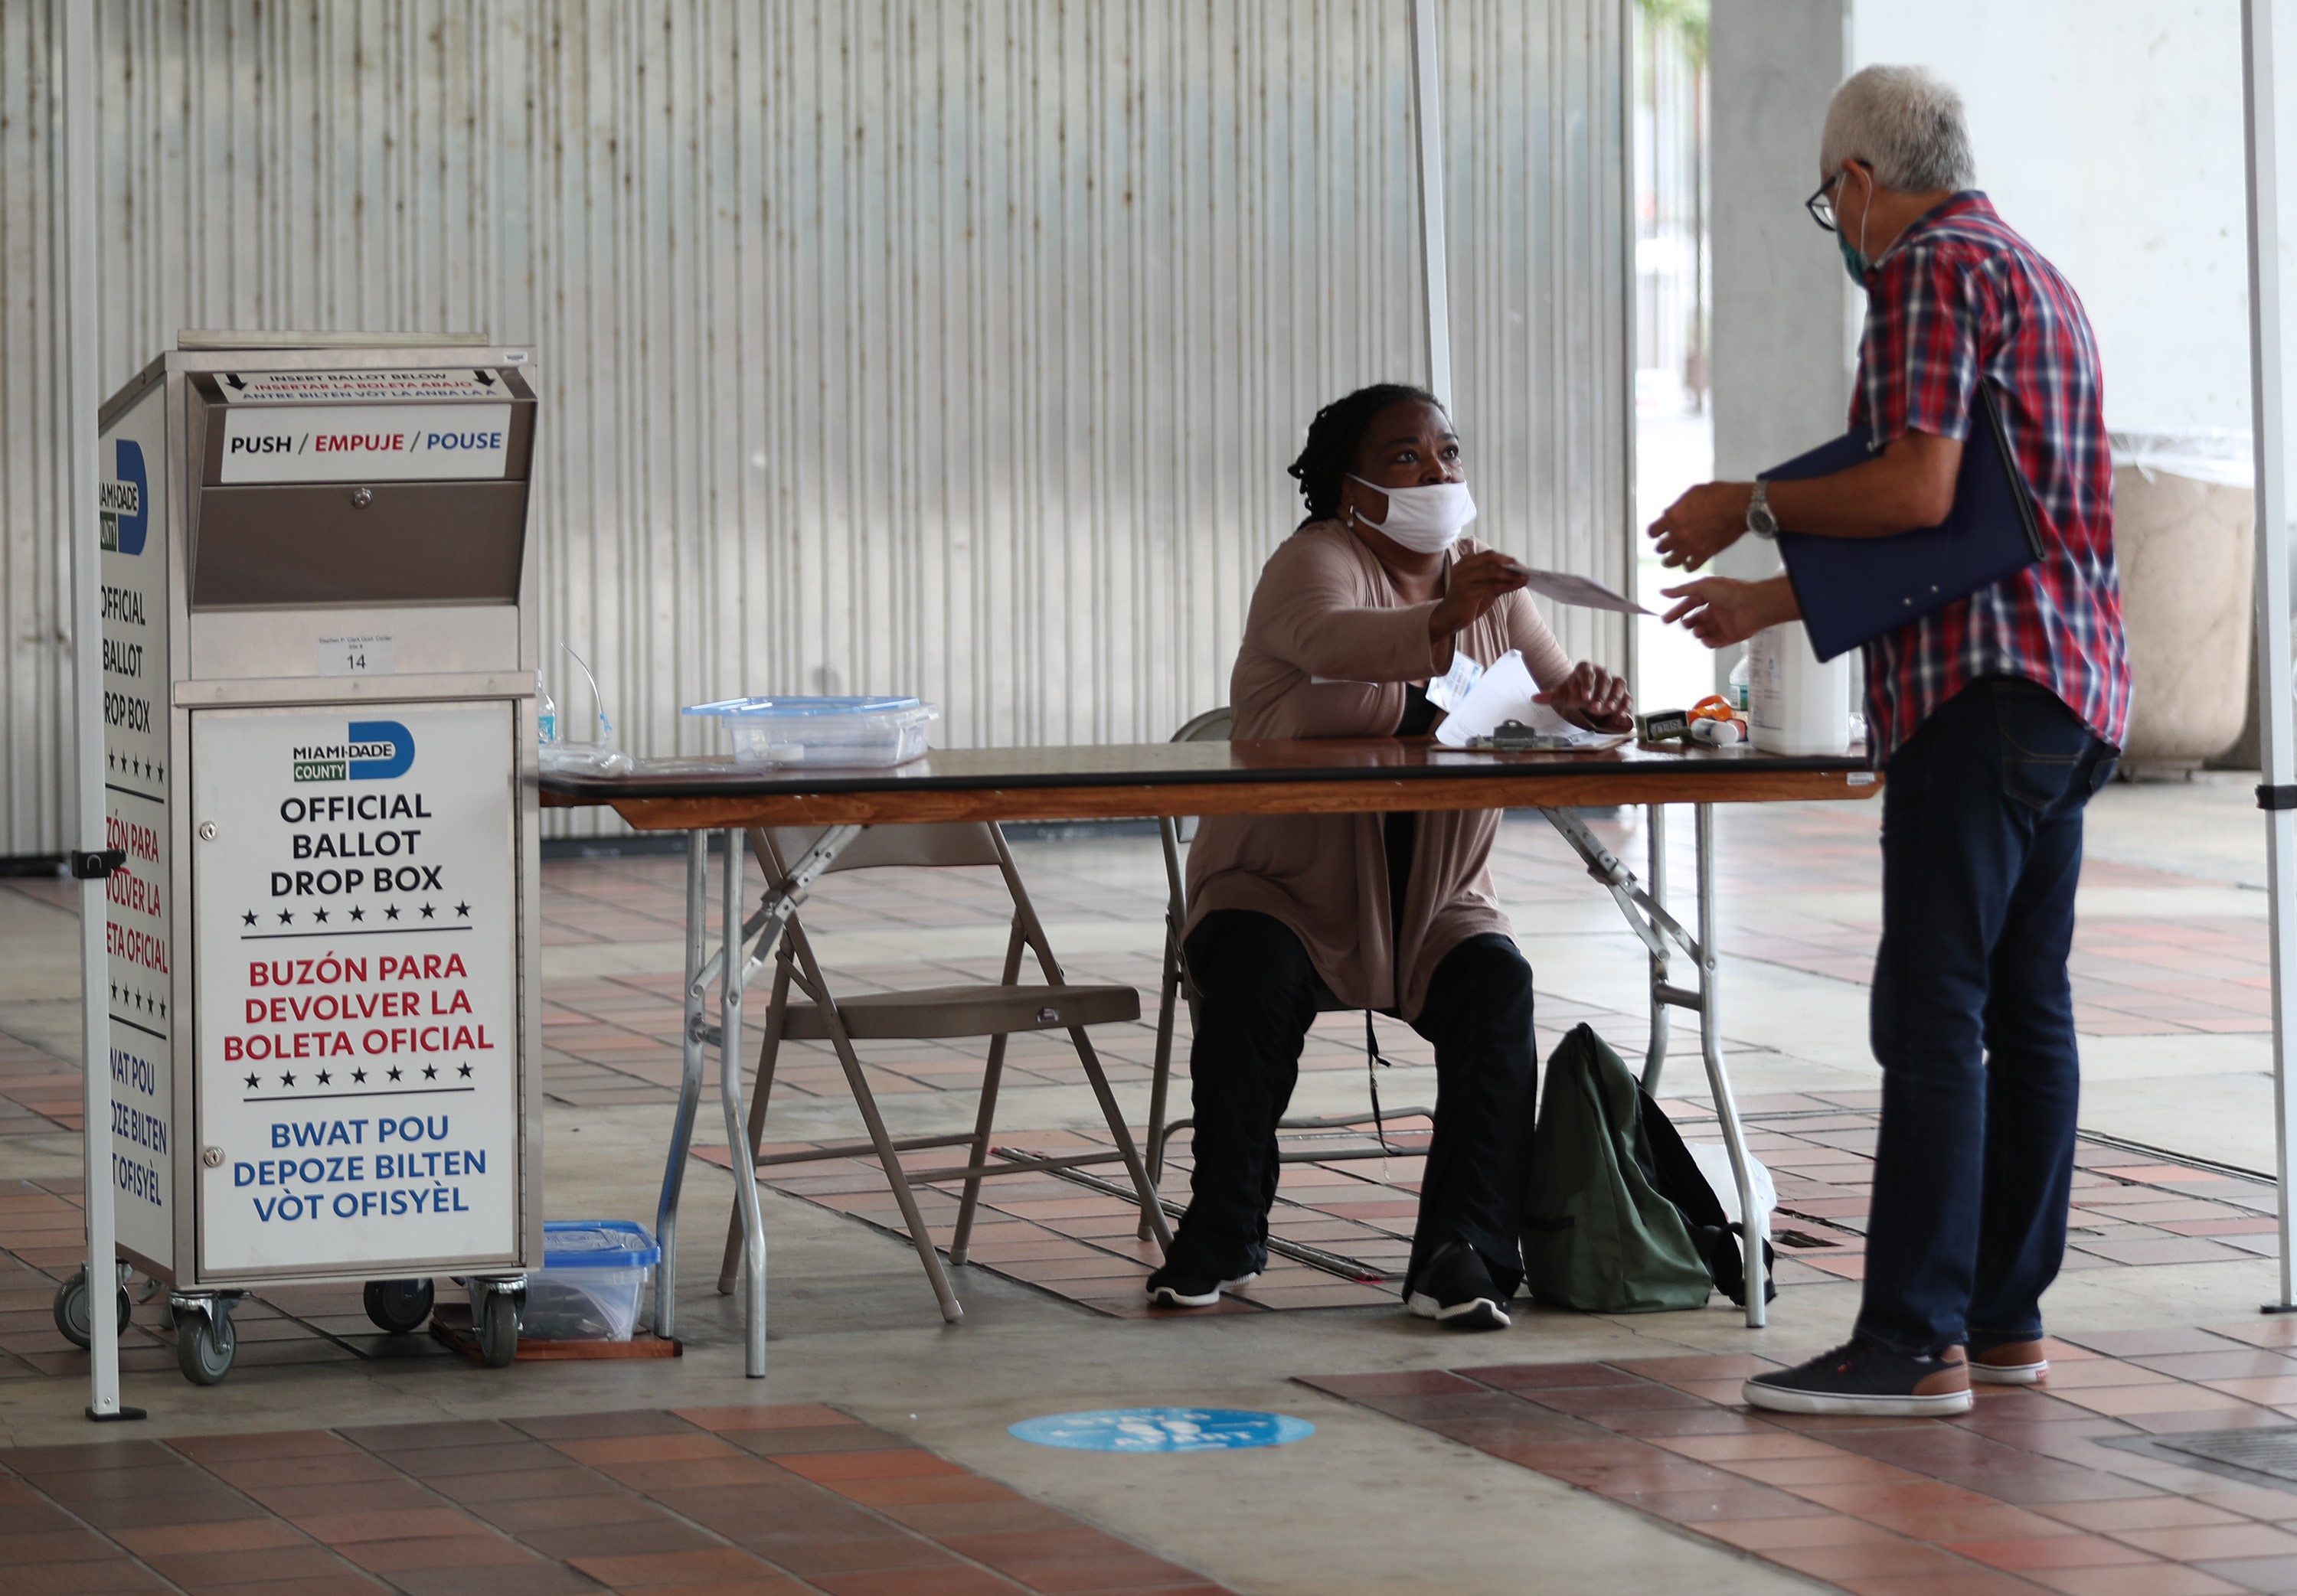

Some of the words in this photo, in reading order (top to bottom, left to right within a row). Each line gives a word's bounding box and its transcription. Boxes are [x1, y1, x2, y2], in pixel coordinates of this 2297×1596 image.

[230, 436, 291, 453] PUSH
[315, 434, 404, 452] EMPUJE
[426, 433, 502, 450] POUSE
[103, 638, 143, 678] BALLOT
[347, 654, 366, 670] 14
[105, 690, 126, 726] ROP
[128, 696, 151, 734] BOX
[293, 743, 393, 760] MIAMI-DADE
[295, 765, 345, 780] COUNTY
[280, 794, 432, 823] OFFICIAL
[106, 808, 128, 854] ZÓN
[131, 823, 159, 863] PARA
[292, 831, 421, 859] BALLOT
[106, 870, 145, 912] VOLVER
[148, 882, 161, 919] LA
[271, 870, 364, 897] DROP
[374, 866, 443, 893] BOX
[127, 928, 168, 974] OFICIAL
[250, 951, 368, 986] BUZÓN
[379, 954, 468, 981] PARA
[245, 992, 420, 1023] DEVOLVER
[431, 989, 472, 1015] LA
[224, 1032, 355, 1062] BOLETA
[362, 1025, 495, 1055] OFICIAL
[132, 1055, 154, 1096] POU
[131, 1108, 167, 1155] BILTEN
[271, 1120, 369, 1148] BWAT
[378, 1116, 449, 1143] POU
[119, 1159, 162, 1206] OFISYÈL
[234, 1157, 364, 1187] DEPOZE
[375, 1149, 486, 1180] BILTEN
[253, 1188, 325, 1222] VÒT
[332, 1180, 469, 1219] OFISYÈL
